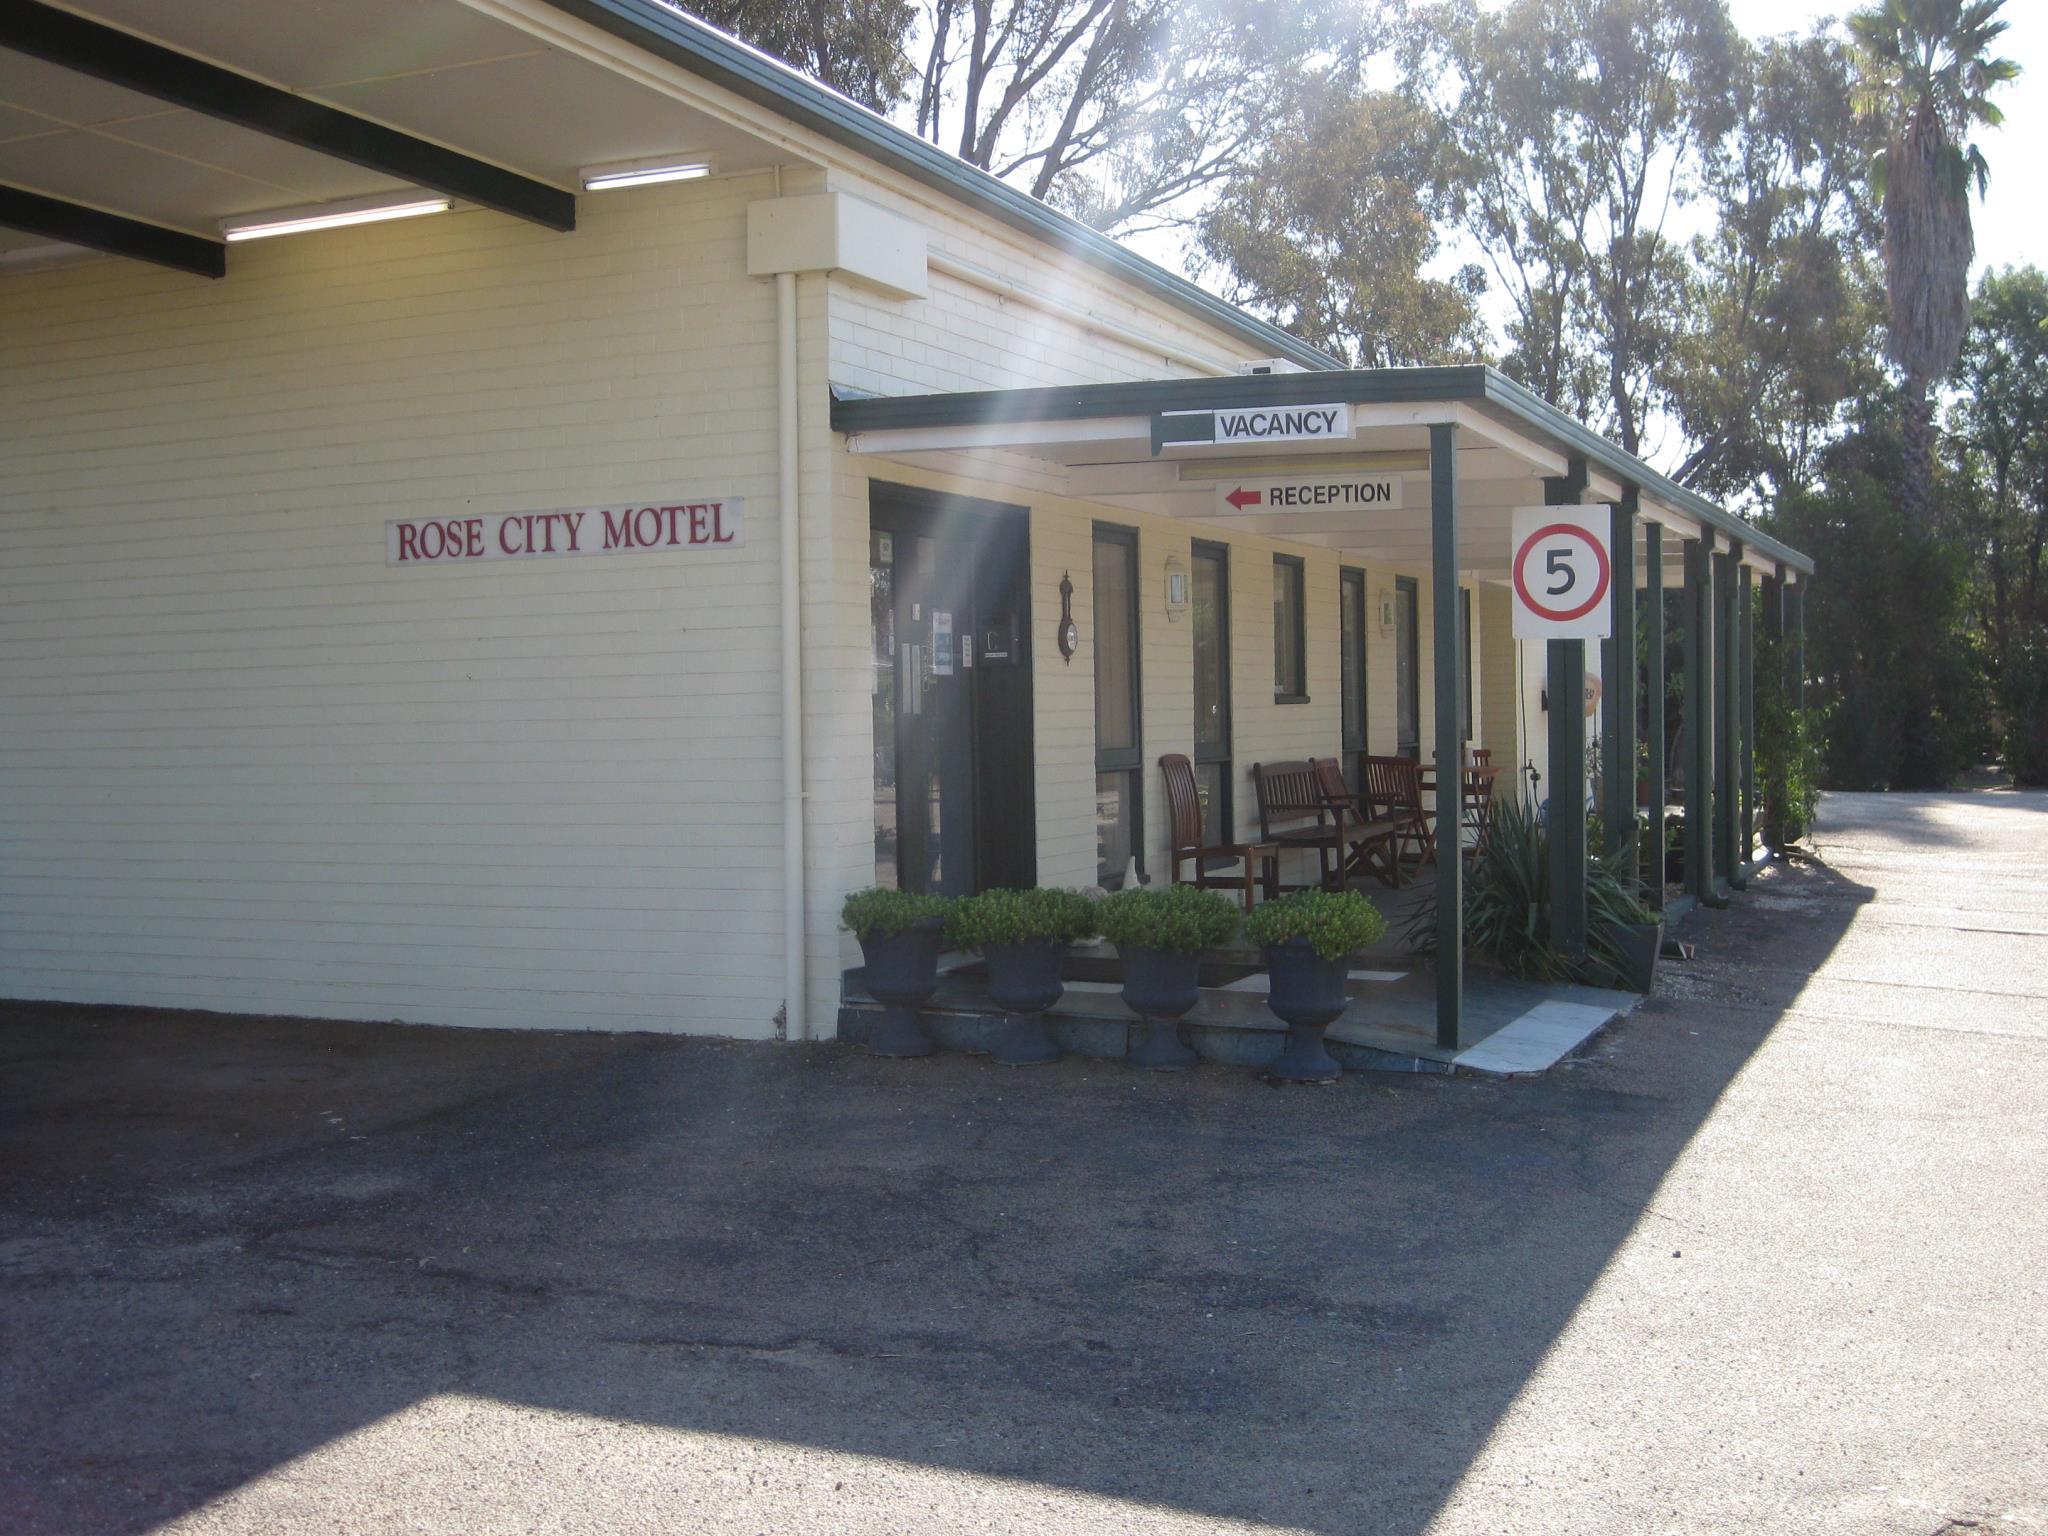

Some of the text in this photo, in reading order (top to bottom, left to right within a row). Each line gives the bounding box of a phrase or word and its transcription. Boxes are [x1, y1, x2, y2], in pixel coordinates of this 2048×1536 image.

[1220, 410, 1338, 438] VACANCY
[1269, 483, 1391, 506] RECEPTION
[397, 503, 734, 561] ROSE CITY MOTEL
[1546, 549, 1576, 596] 5
